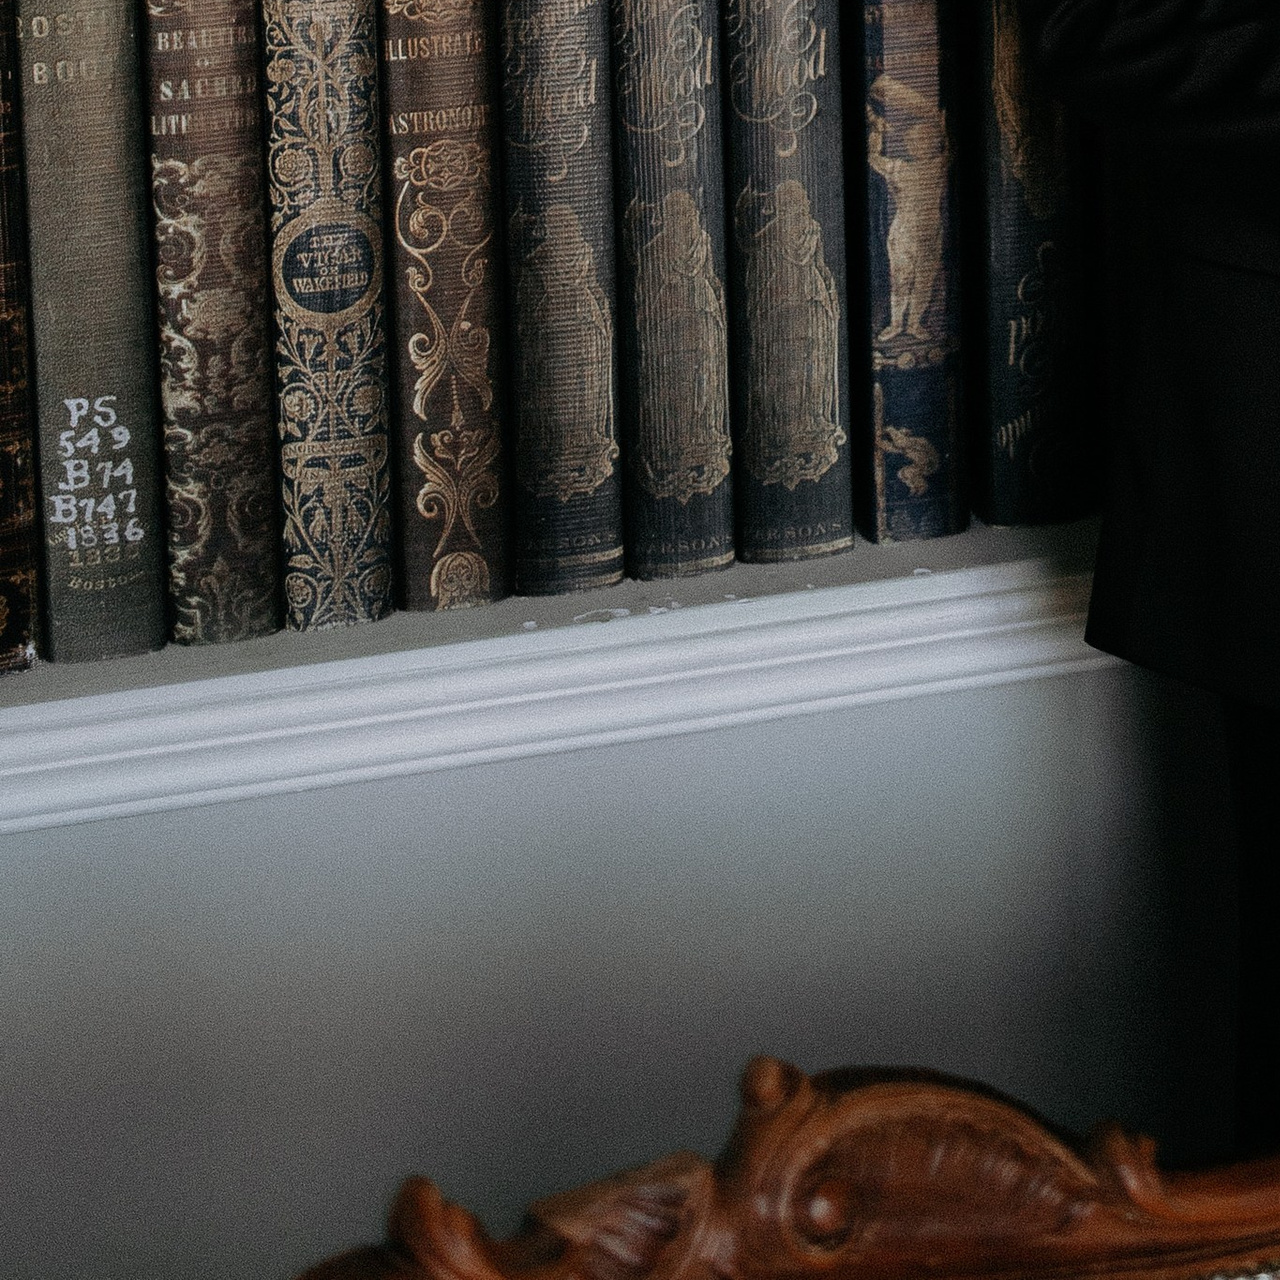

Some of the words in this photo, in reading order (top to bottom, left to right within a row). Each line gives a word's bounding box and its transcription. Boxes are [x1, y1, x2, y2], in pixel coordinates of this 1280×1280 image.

[296, 244, 363, 269] VICAR
[310, 233, 349, 249] THE
[292, 271, 369, 294] WAKEFIELD
[63, 396, 117, 428] PS
[58, 426, 131, 458] 549
[59, 458, 134, 490] B74
[50, 489, 137, 523] B747
[67, 518, 144, 550] 1836
